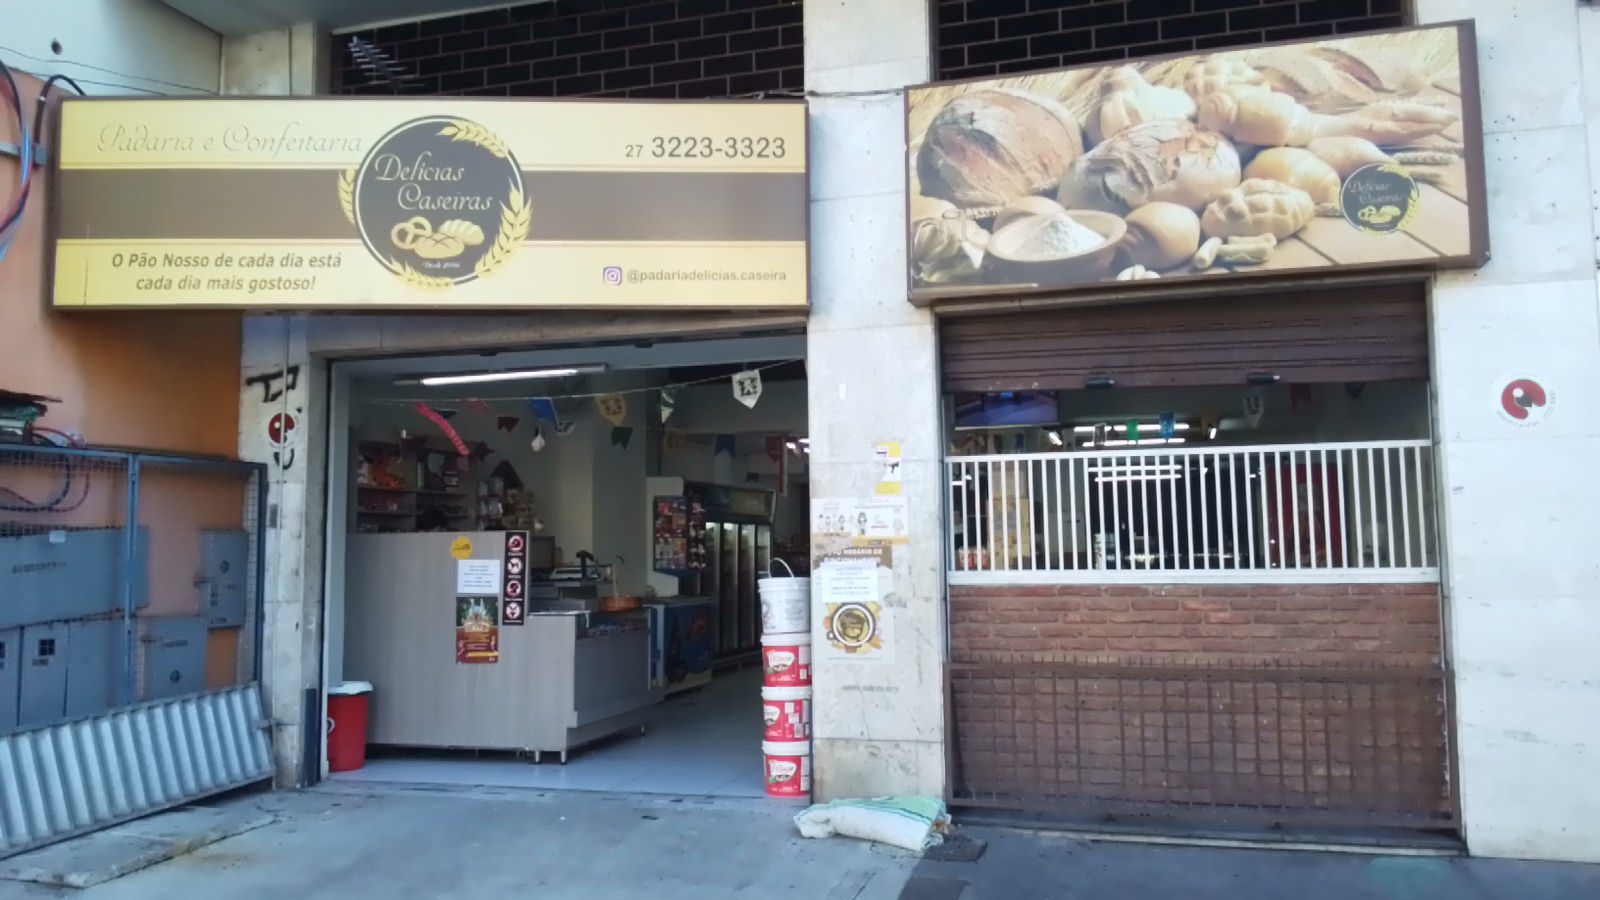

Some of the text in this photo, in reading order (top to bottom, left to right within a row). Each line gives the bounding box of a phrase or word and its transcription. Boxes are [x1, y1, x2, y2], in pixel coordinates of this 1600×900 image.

[97, 121, 362, 158] Padaria e Confeitaria
[625, 136, 786, 159] 27 3223-3323
[398, 183, 494, 210] Caseiras
[112, 252, 342, 268] O Pão Nosso de cada dia está
[136, 276, 316, 295] cada dia mais gostoso!
[627, 269, 787, 283] @padariadelicias.caseira
